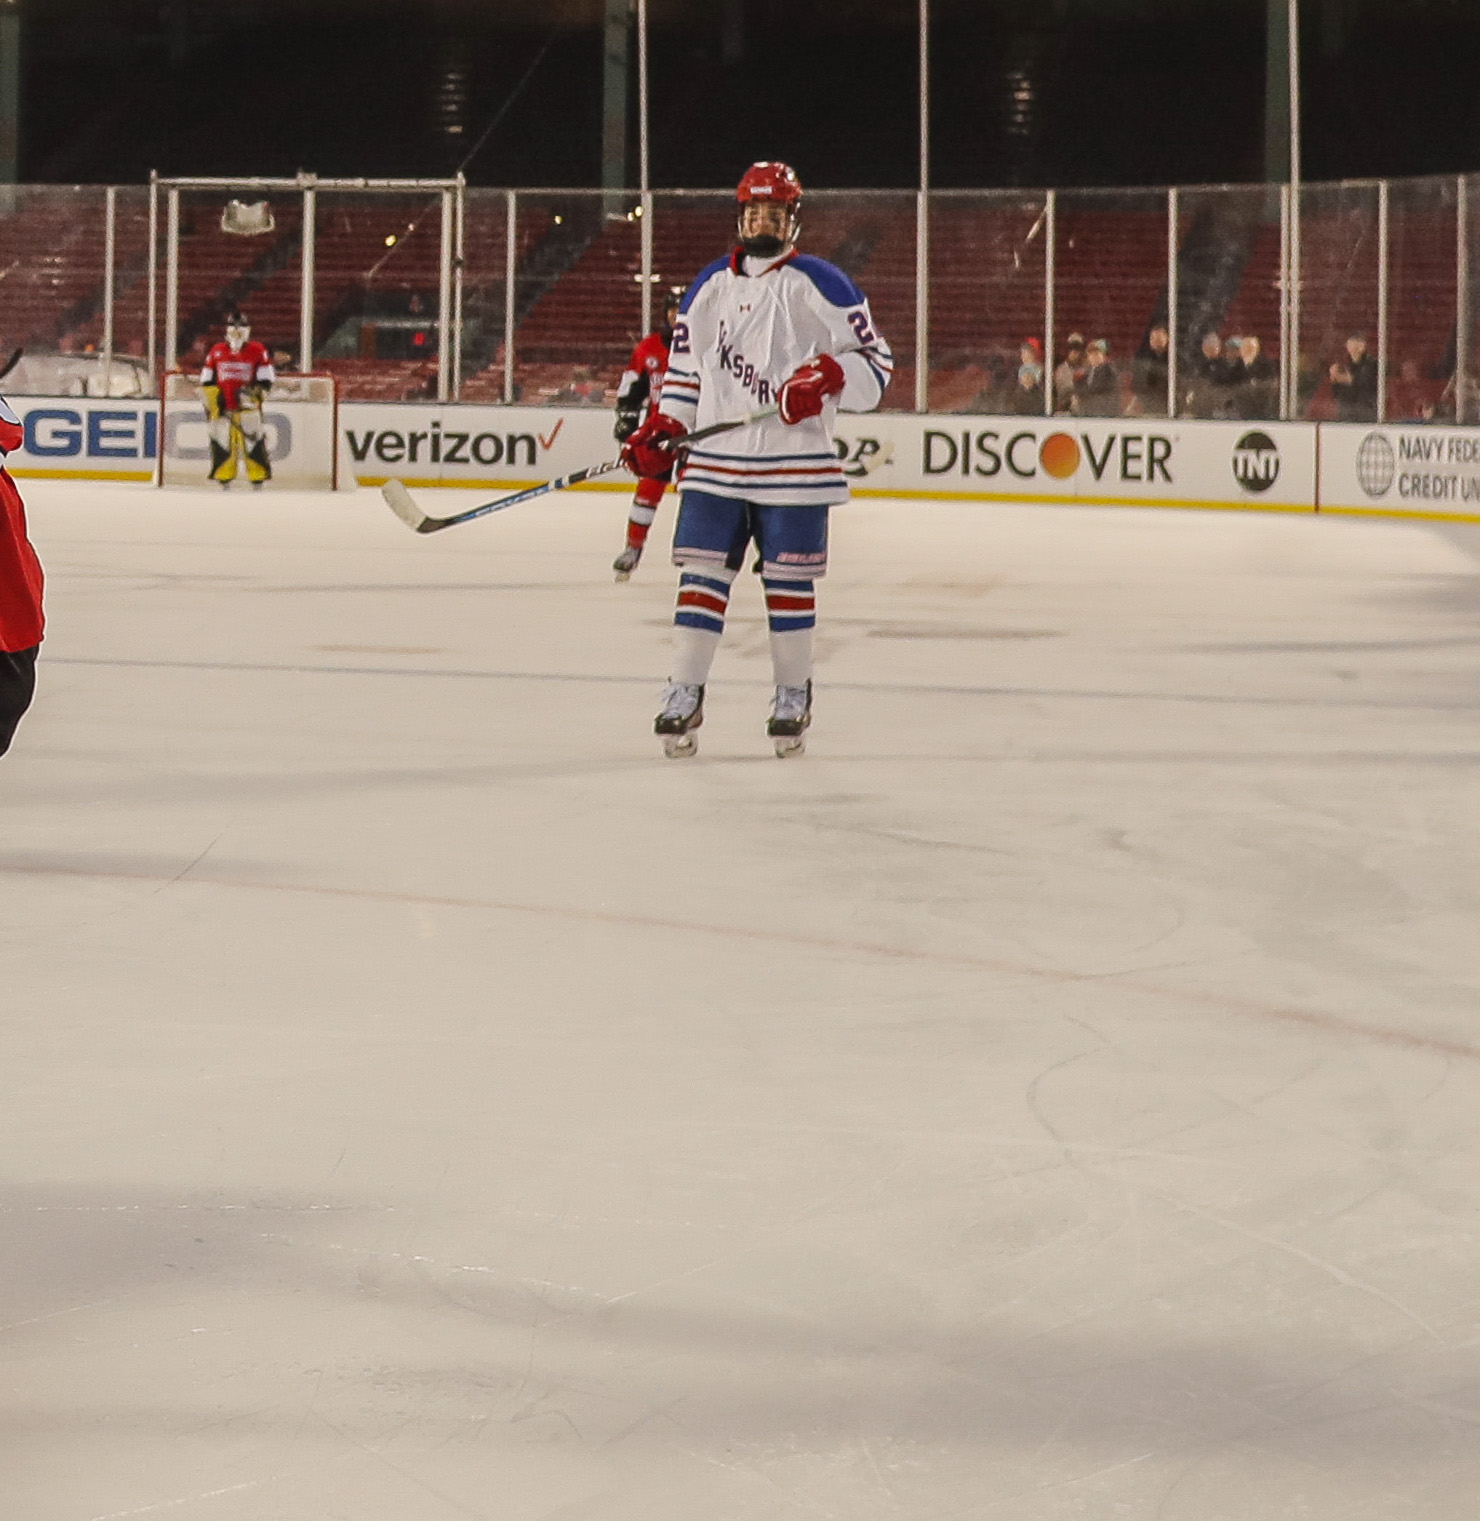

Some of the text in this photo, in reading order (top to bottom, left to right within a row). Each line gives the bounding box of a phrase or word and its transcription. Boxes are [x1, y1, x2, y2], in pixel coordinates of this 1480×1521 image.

[345, 420, 537, 466] verizon
[922, 429, 1174, 483] DISCOVER
[1398, 434, 1444, 460] NAVY
[1233, 452, 1279, 483] TNT
[1399, 472, 1458, 499] CREDIT
